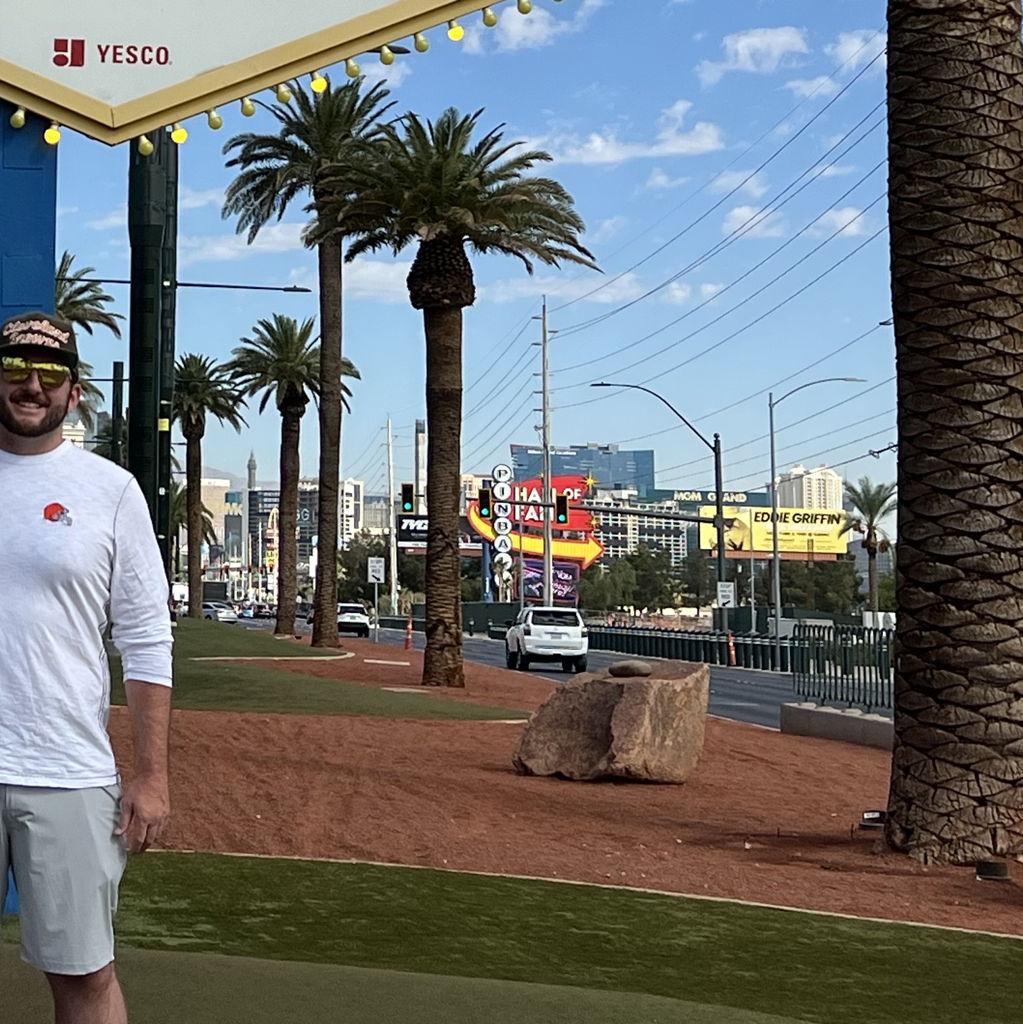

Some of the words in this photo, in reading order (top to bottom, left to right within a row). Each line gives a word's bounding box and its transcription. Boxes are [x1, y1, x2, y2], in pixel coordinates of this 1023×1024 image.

[97, 44, 171, 66] YESCO
[674, 491, 702, 501] MGM
[708, 492, 747, 503] GAND
[754, 512, 791, 523] EDDIE
[792, 513, 841, 524] GRIFFIN
